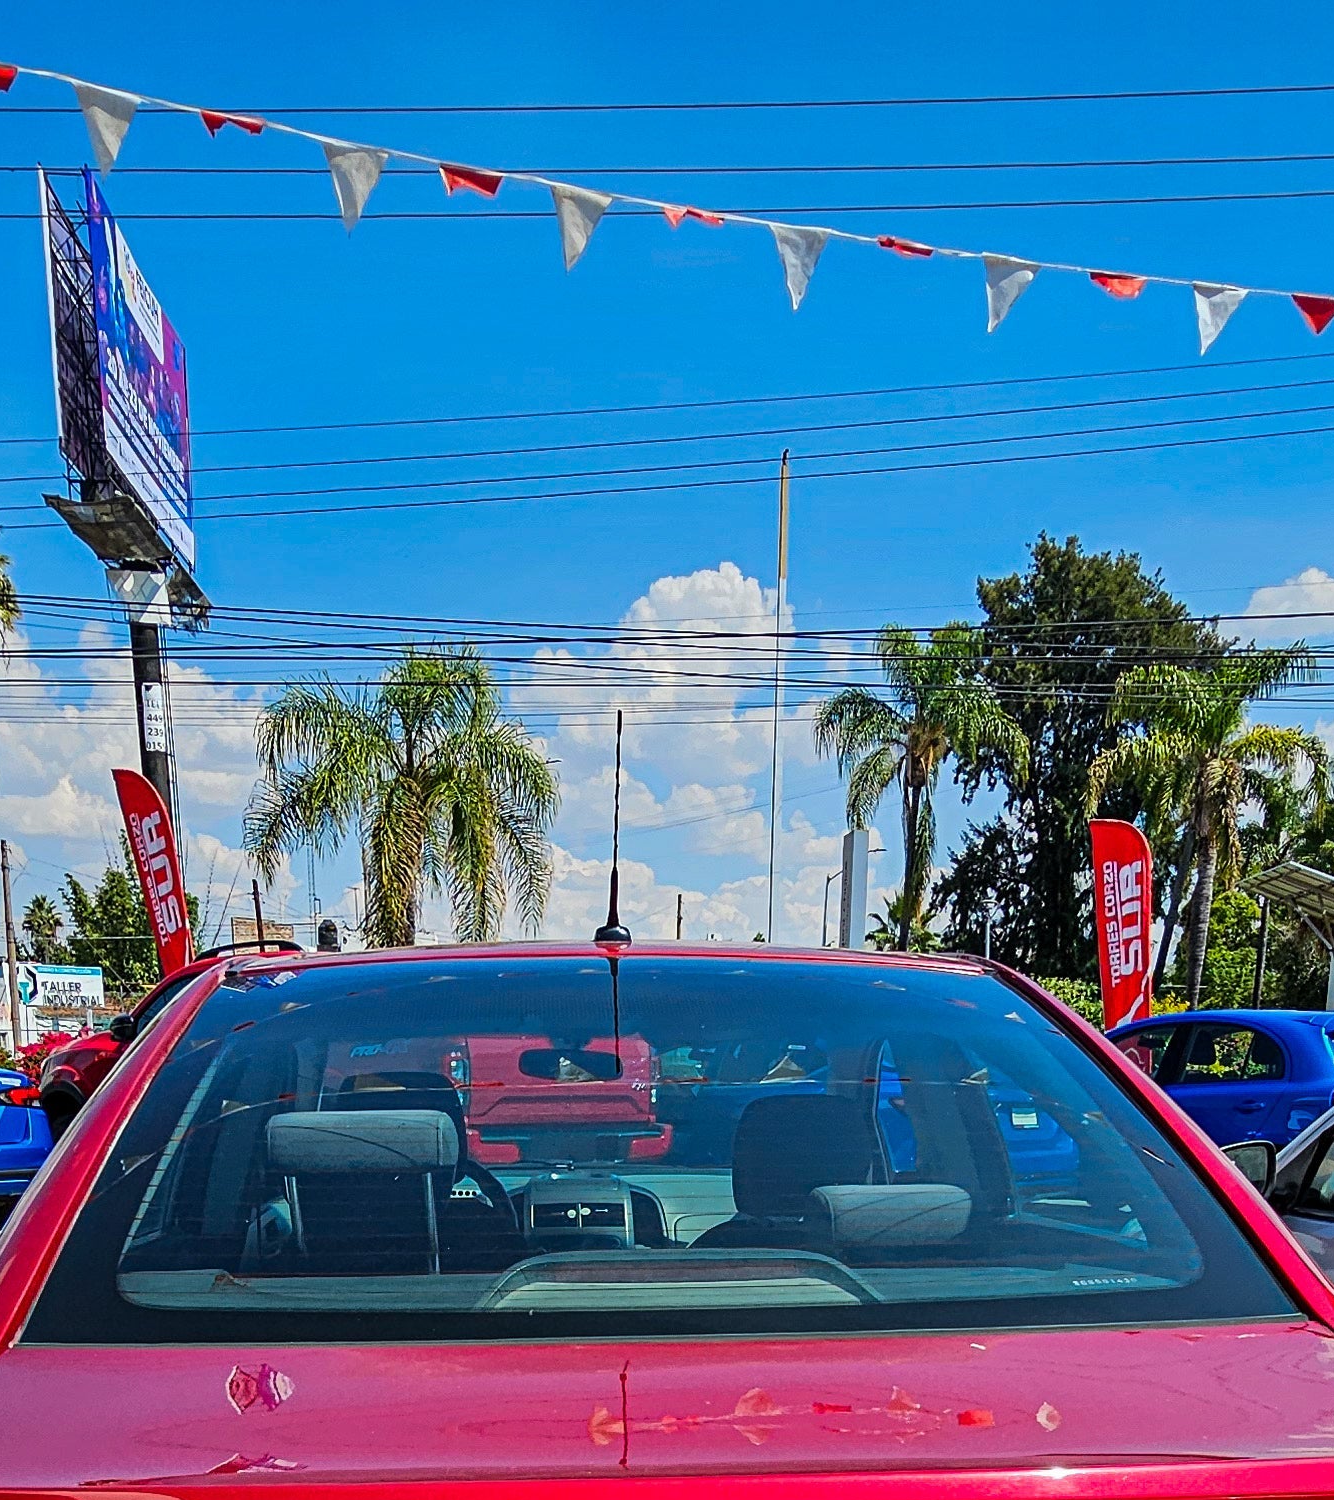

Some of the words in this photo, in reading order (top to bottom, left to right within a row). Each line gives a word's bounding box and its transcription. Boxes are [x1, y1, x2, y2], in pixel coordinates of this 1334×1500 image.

[128, 812, 149, 872] CORZO
[141, 810, 183, 935] SUR
[1103, 861, 1116, 917] CORZO
[1119, 860, 1143, 977] SUR
[1106, 922, 1121, 987] TORRES
[40, 981, 82, 993] TALLER
[43, 995, 103, 1006] INDUSTRIAL
